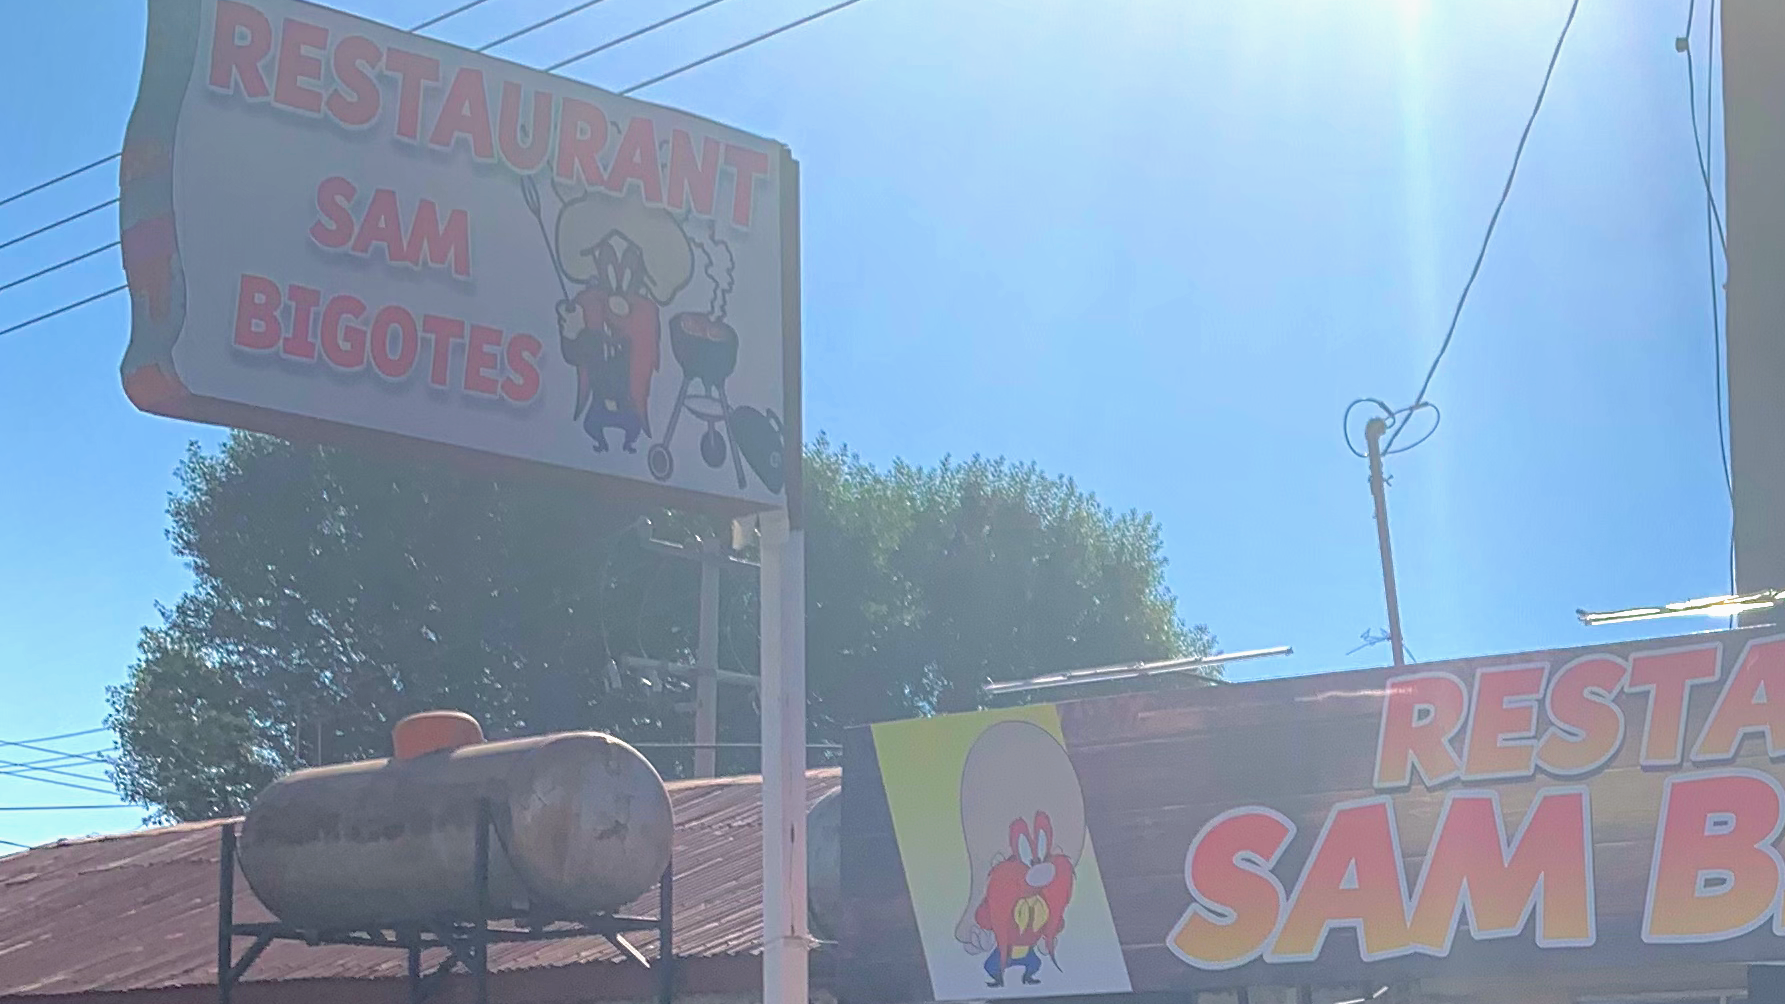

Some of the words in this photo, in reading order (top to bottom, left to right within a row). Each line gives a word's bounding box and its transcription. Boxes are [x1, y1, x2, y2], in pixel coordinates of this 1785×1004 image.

[208, 0, 771, 229] RESTAURANT
[308, 175, 471, 279] SAM
[233, 272, 544, 403] BIGOTES
[1166, 786, 1597, 970] SAM
